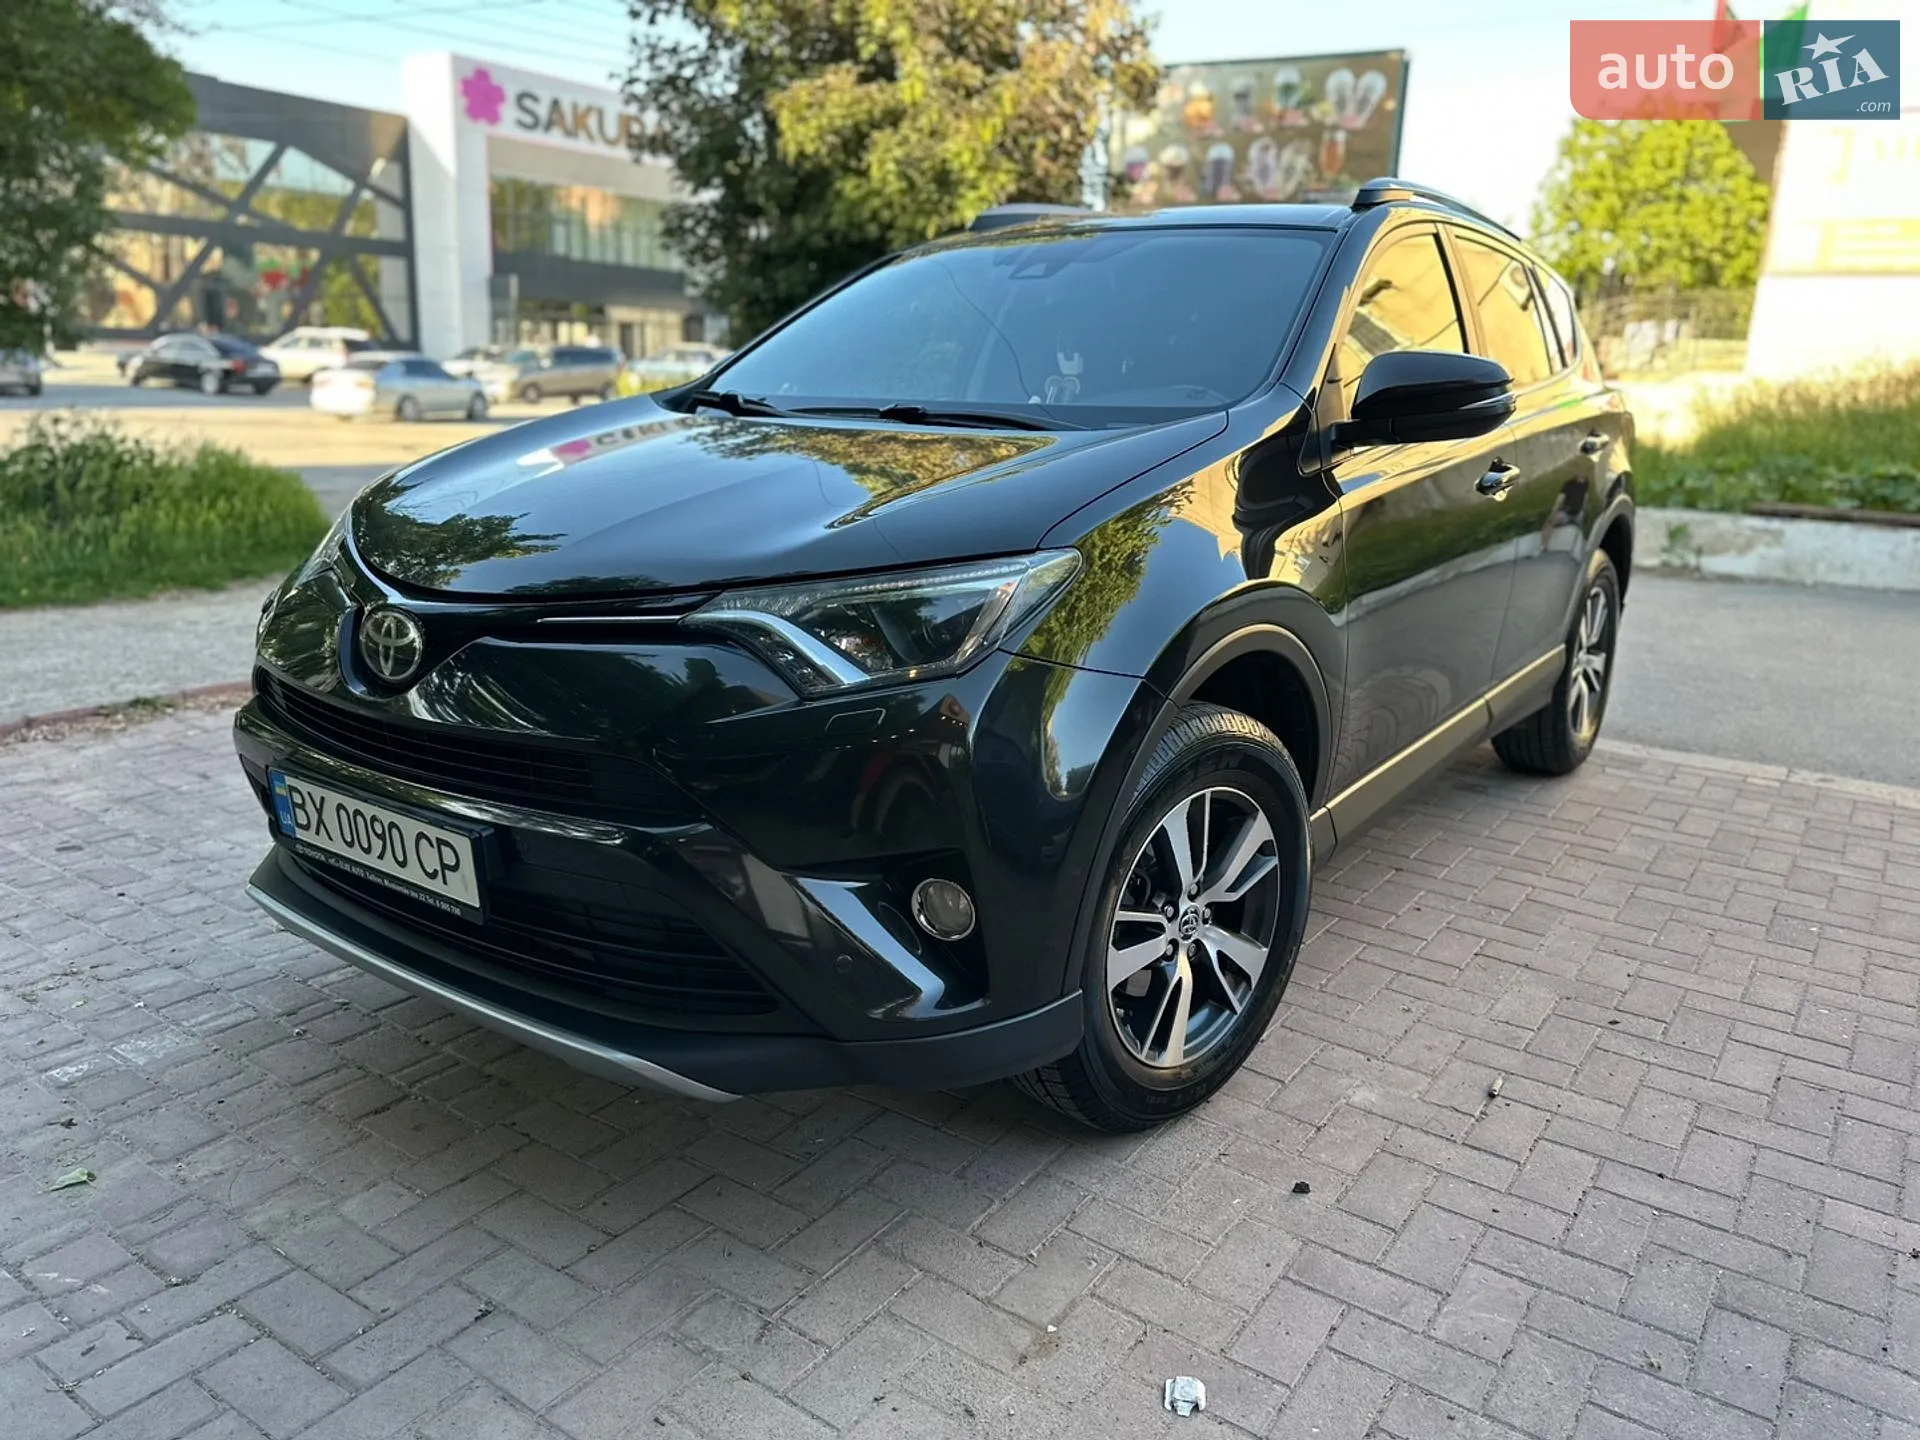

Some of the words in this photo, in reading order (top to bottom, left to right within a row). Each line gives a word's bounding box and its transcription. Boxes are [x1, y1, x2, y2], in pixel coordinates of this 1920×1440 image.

[280, 810, 293, 826] UA
[288, 784, 333, 841] BX
[335, 802, 408, 869] 0090
[415, 830, 461, 886] CP
